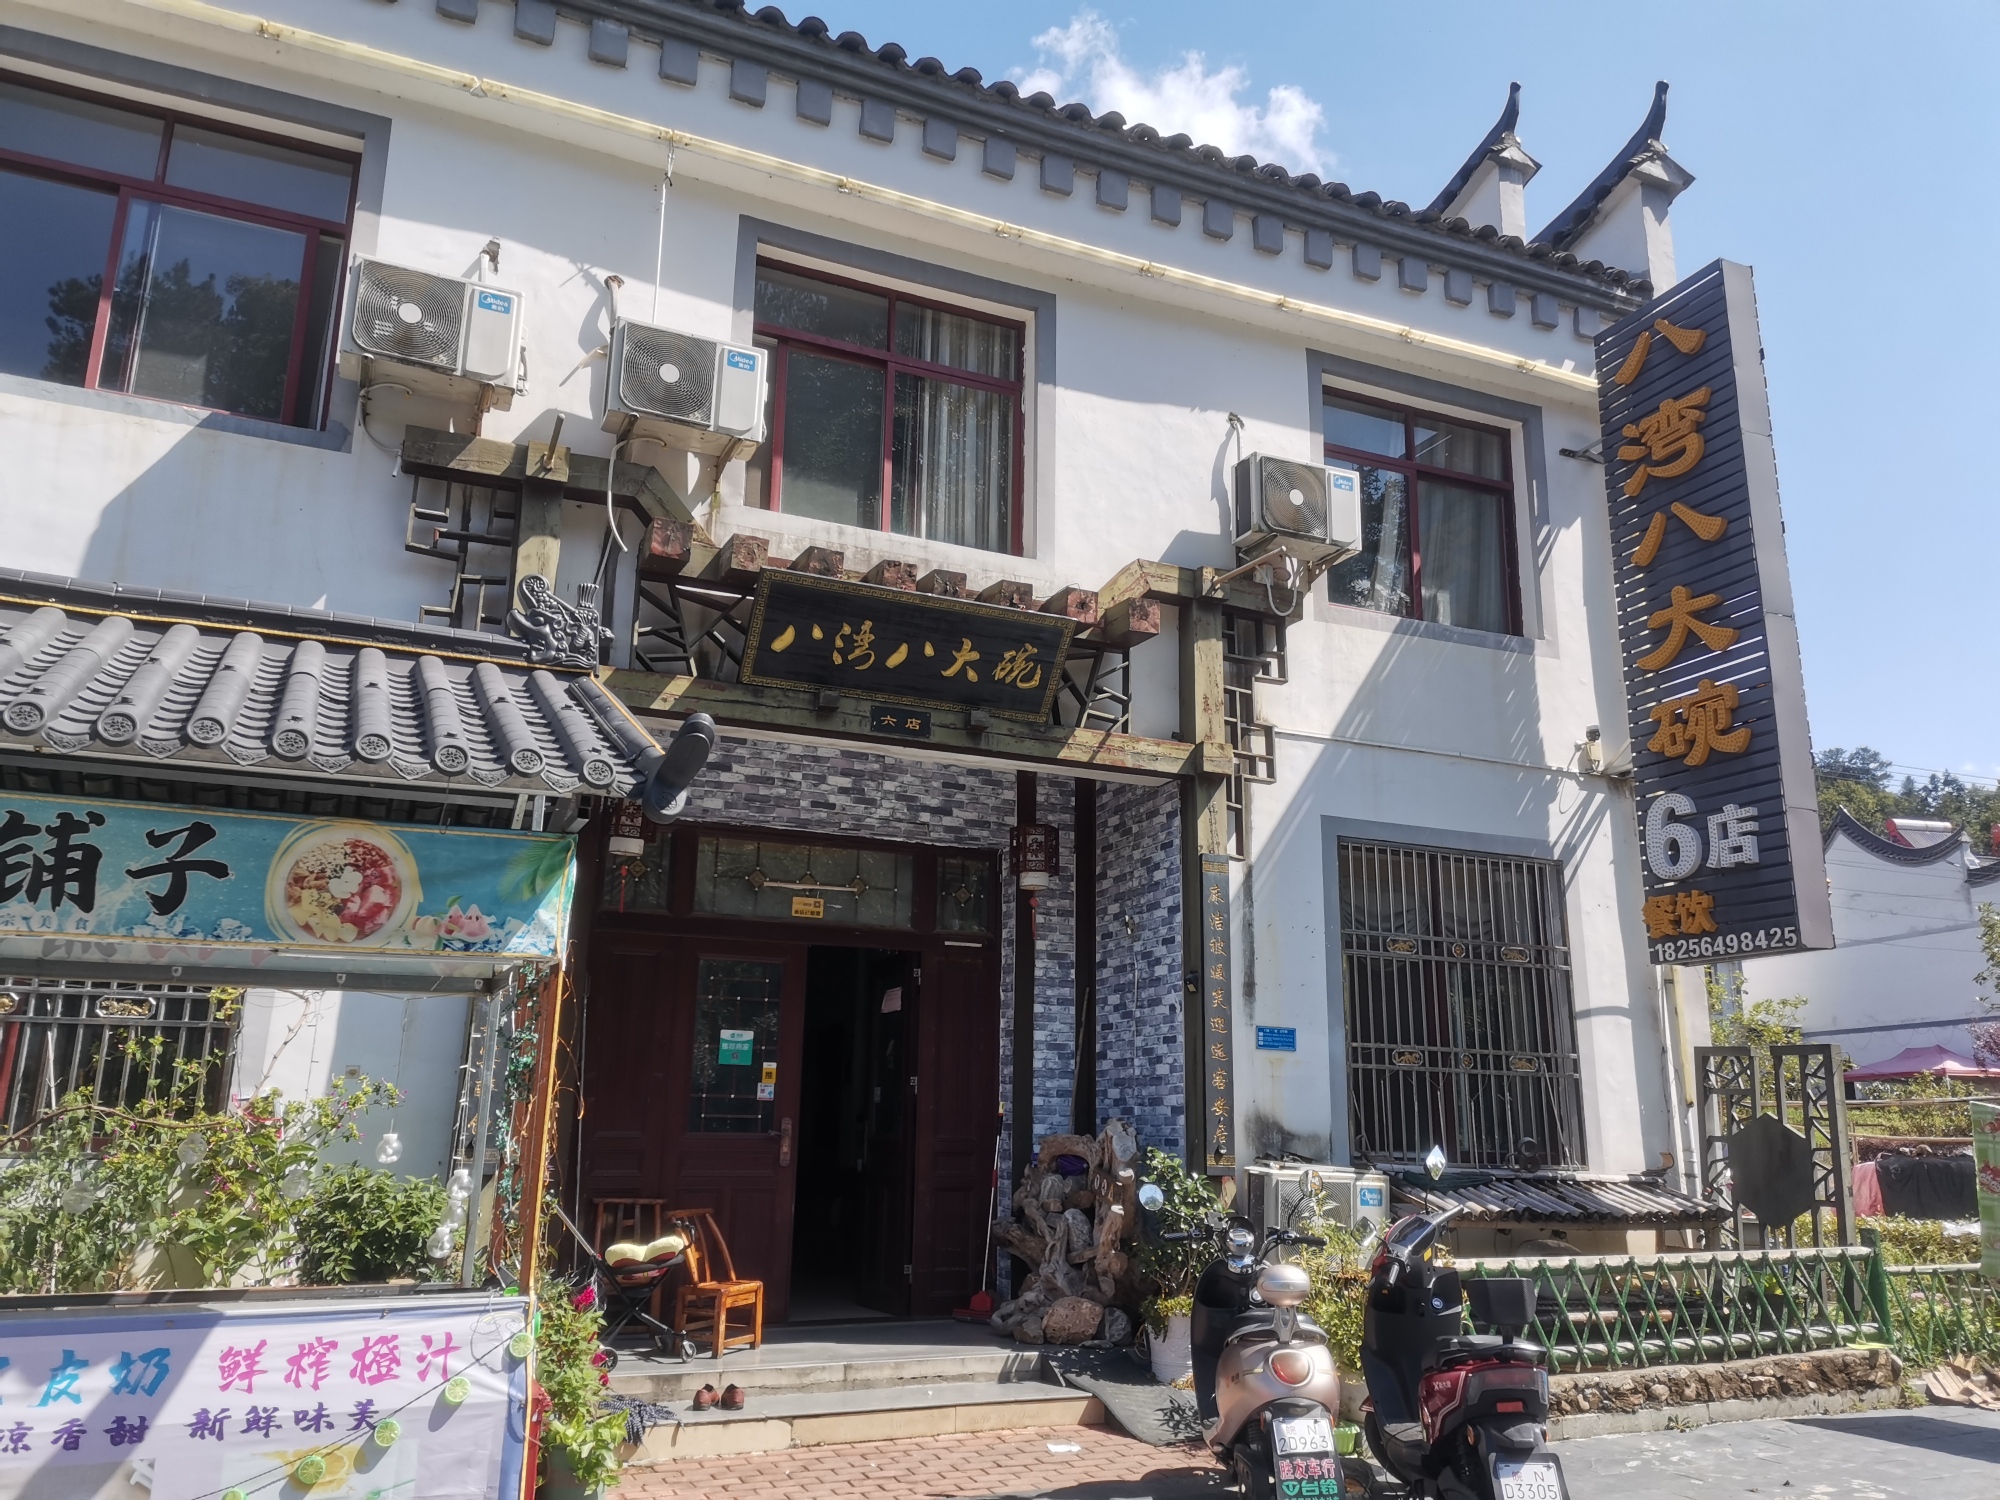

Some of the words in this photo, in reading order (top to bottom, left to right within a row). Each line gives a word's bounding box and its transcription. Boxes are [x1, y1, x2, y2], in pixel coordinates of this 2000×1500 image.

[1614, 318, 1751, 766] 八湾八大碗
[880, 715, 921, 731] 六店
[1646, 793, 1759, 880] 6店
[0, 810, 230, 915] 铺子
[1641, 890, 1718, 939] 餐饮
[1655, 926, 1797, 961] 18256498425
[0, 1348, 170, 1407] 皮奶
[218, 1332, 463, 1393] 鲜榨橙汁
[183, 1399, 379, 1442] 新鲜味美
[1306, 1425, 1318, 1436] N
[1278, 1436, 1328, 1453] 2D963
[1279, 1458, 1336, 1480] 胜友车行
[1534, 1470, 1545, 1482] N
[1301, 1479, 1338, 1496] 台铃
[1504, 1483, 1557, 1500] D3305
